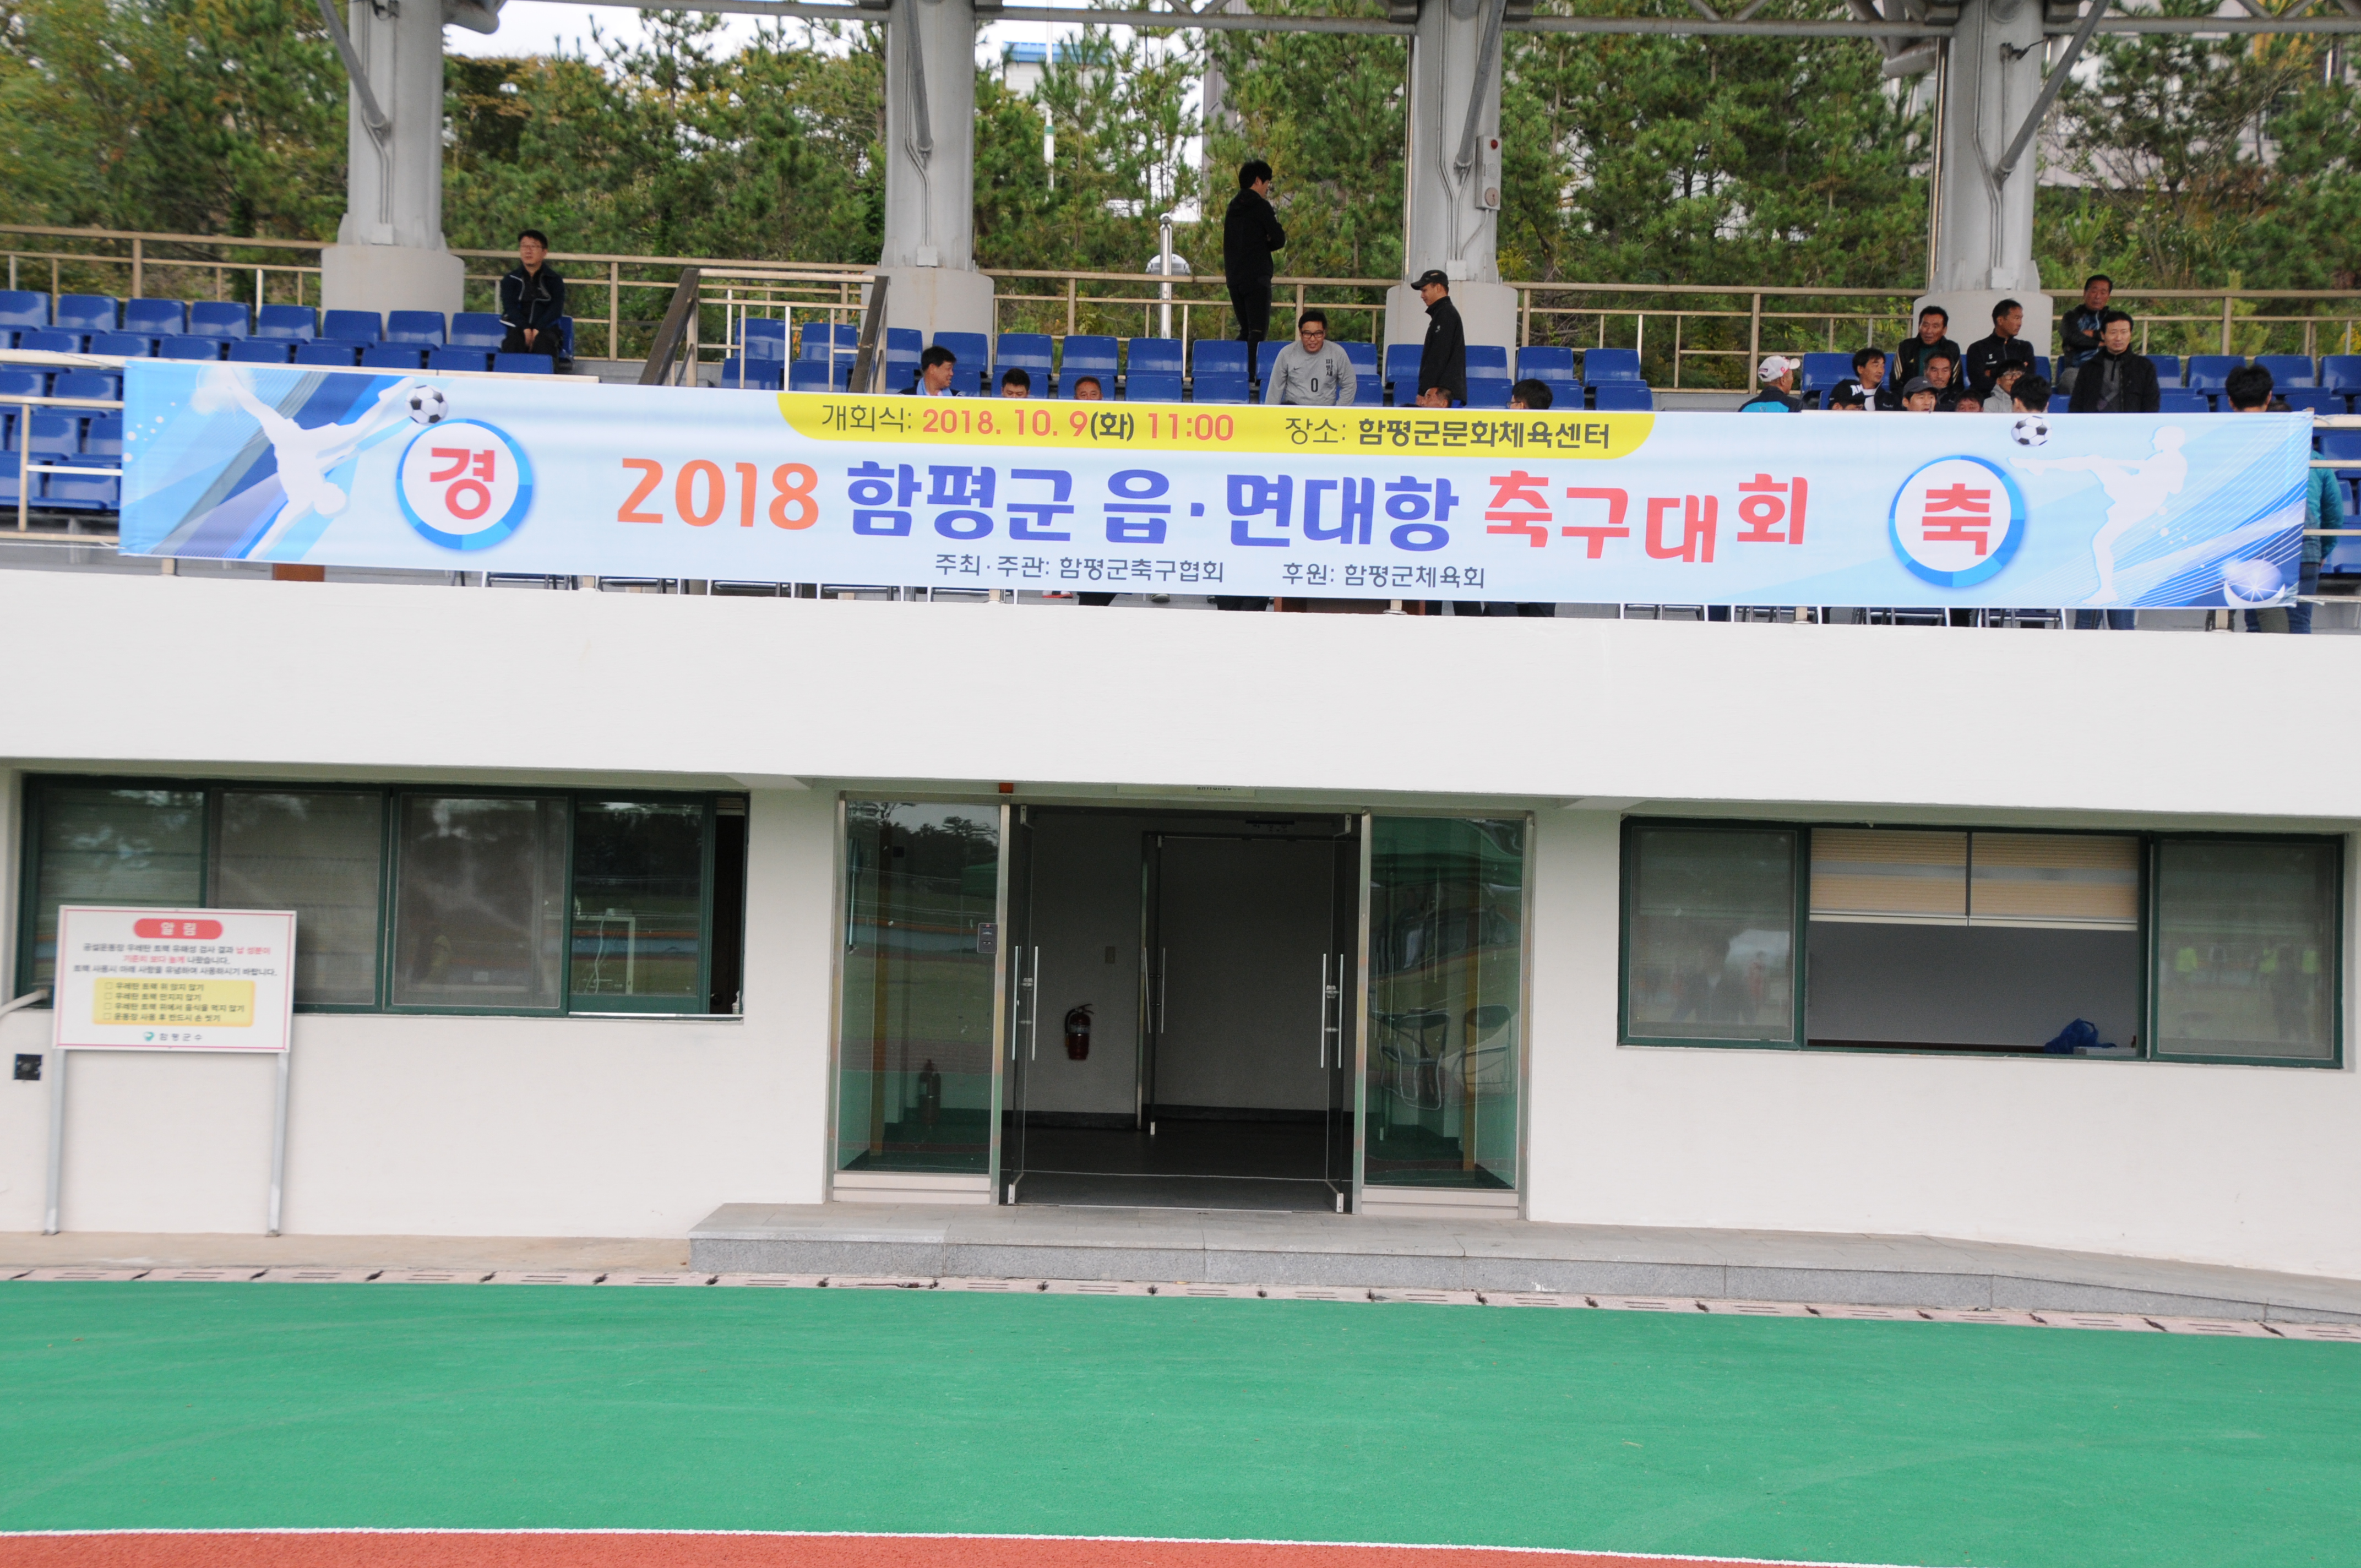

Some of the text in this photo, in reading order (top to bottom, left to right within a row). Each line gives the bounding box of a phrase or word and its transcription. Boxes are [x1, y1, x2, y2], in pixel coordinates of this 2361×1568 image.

[1311, 378, 1318, 392] 0
[822, 405, 1233, 442] 개회식: 2018. 10. 9(화) 11:00
[1286, 418, 1609, 449] 장소: 함평군문화체육센터
[429, 448, 496, 520] 경
[618, 458, 1808, 563] 2018 함평군 읍·면대항 축구대회
[1921, 483, 1991, 556] 축
[1060, 557, 1223, 582] 함평군축구협회
[1282, 563, 1484, 589] 후원: 함평군체육회
[93, 965, 117, 973] 사용시
[200, 967, 240, 976] 사용하시기
[242, 968, 277, 976] 바랍니다.
[187, 956, 230, 964] 나왔습니다.
[116, 982, 139, 990] 우레탄
[115, 1003, 138, 1011] 우레탄
[115, 1013, 138, 1021] 운동장
